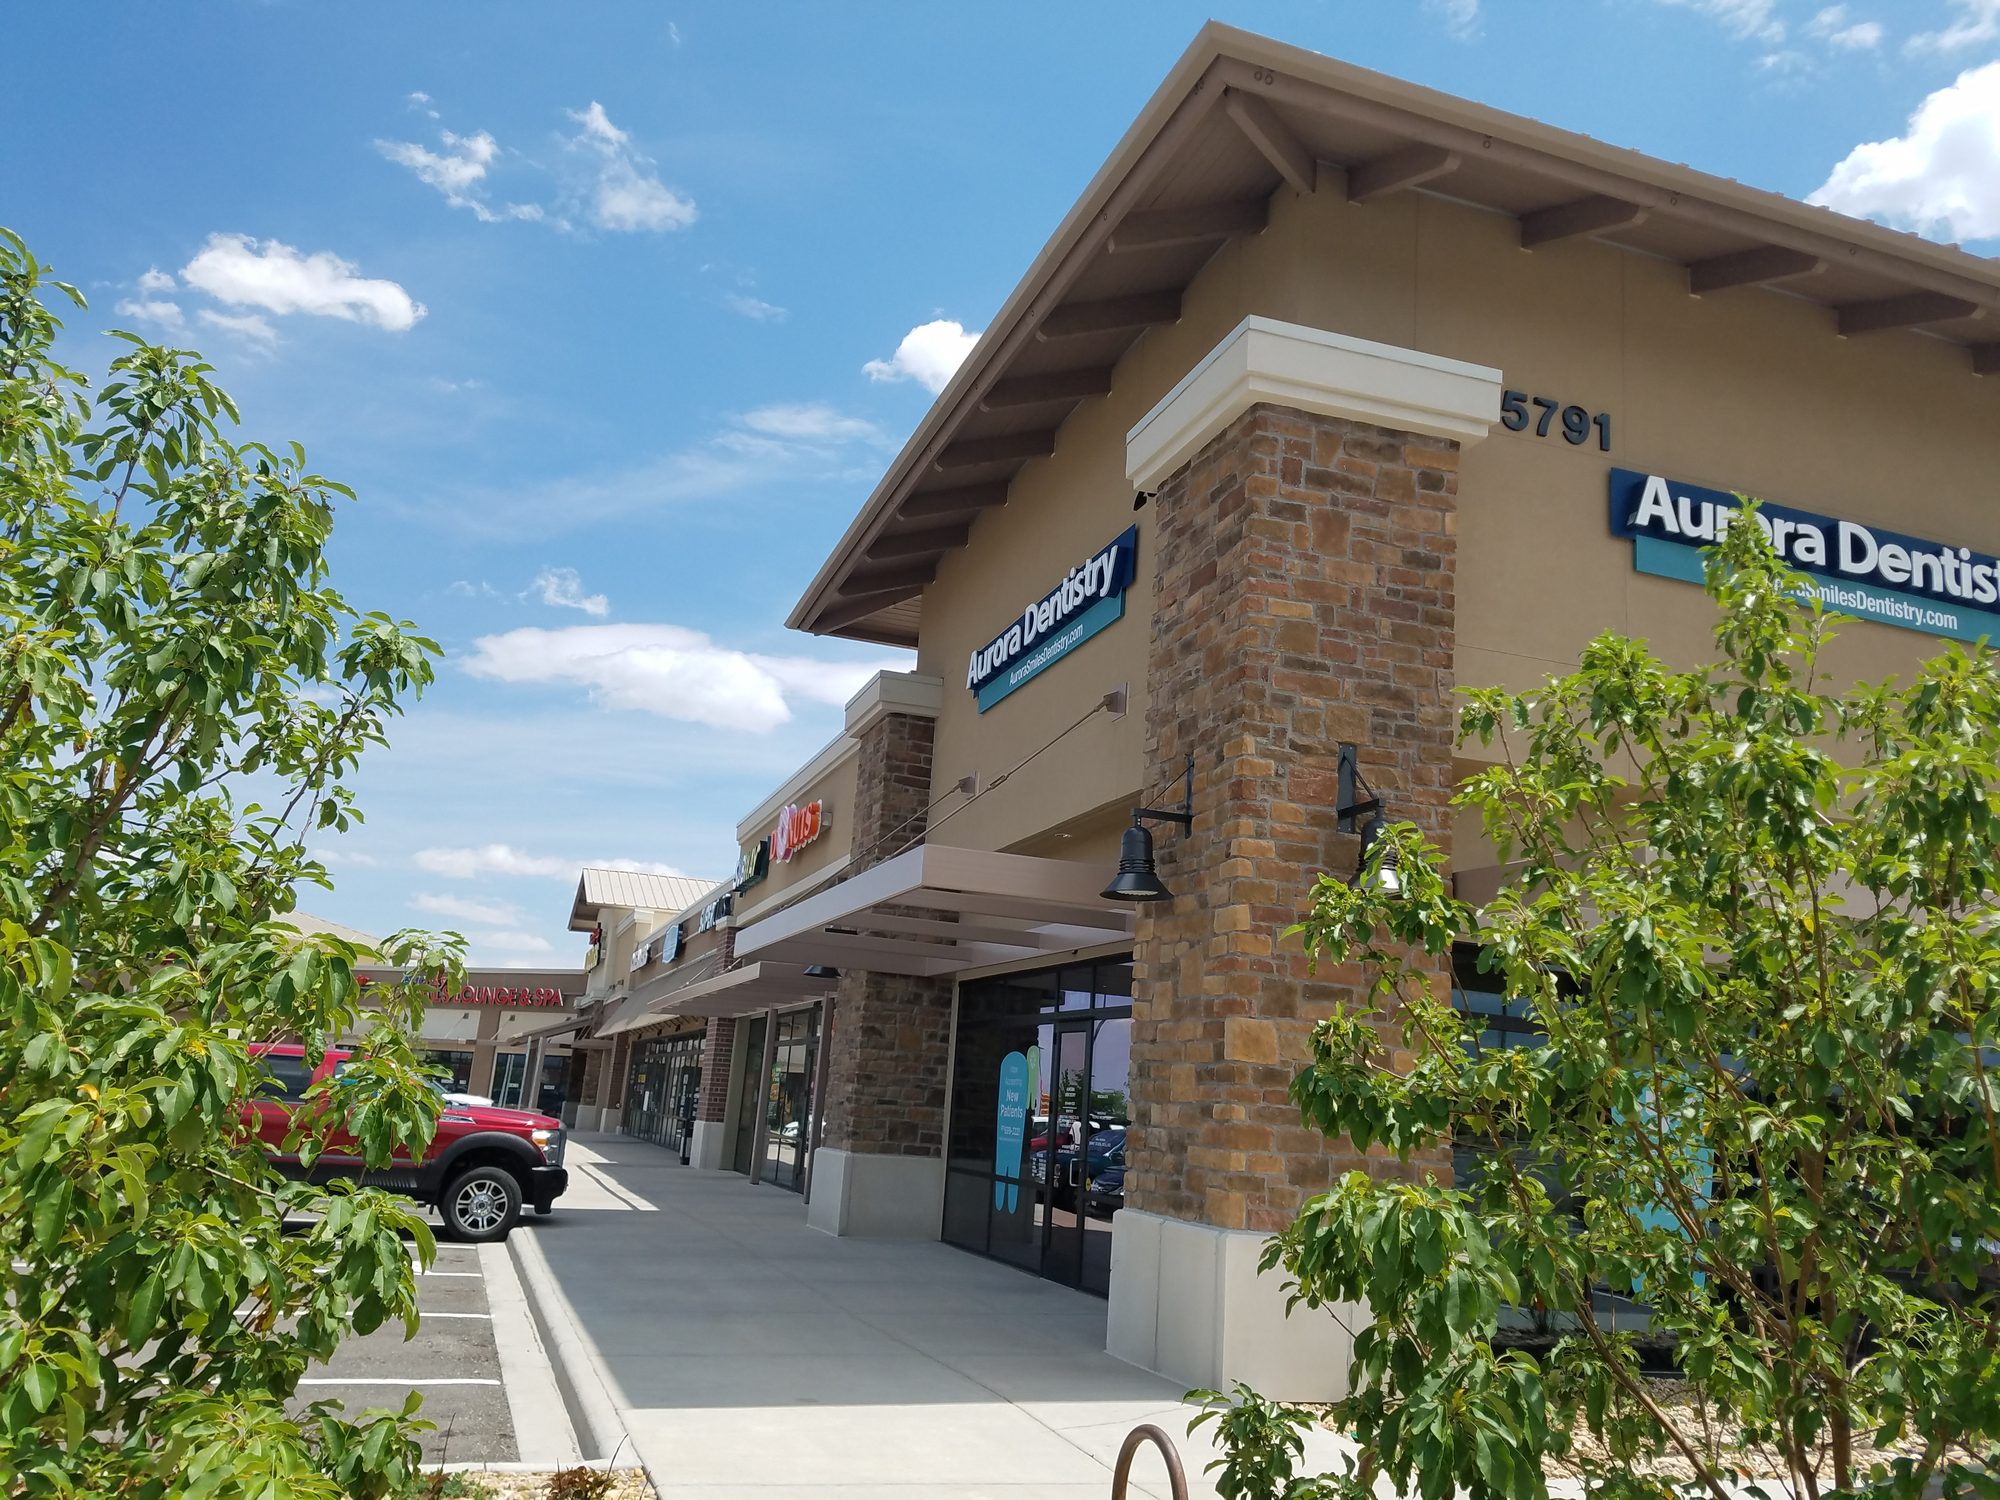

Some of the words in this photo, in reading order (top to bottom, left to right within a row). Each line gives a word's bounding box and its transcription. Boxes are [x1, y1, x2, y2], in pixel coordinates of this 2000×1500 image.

[1501, 390, 1611, 452] 5791
[966, 624, 1022, 689] Aurora
[1023, 545, 1118, 646] Dentistry
[1008, 623, 1084, 687] AuroraSmilesDentistry.com
[518, 987, 532, 1006] &
[535, 988, 564, 1007] SPA
[1000, 1104, 1023, 1119] Patients
[1006, 1088, 1019, 1103] New
